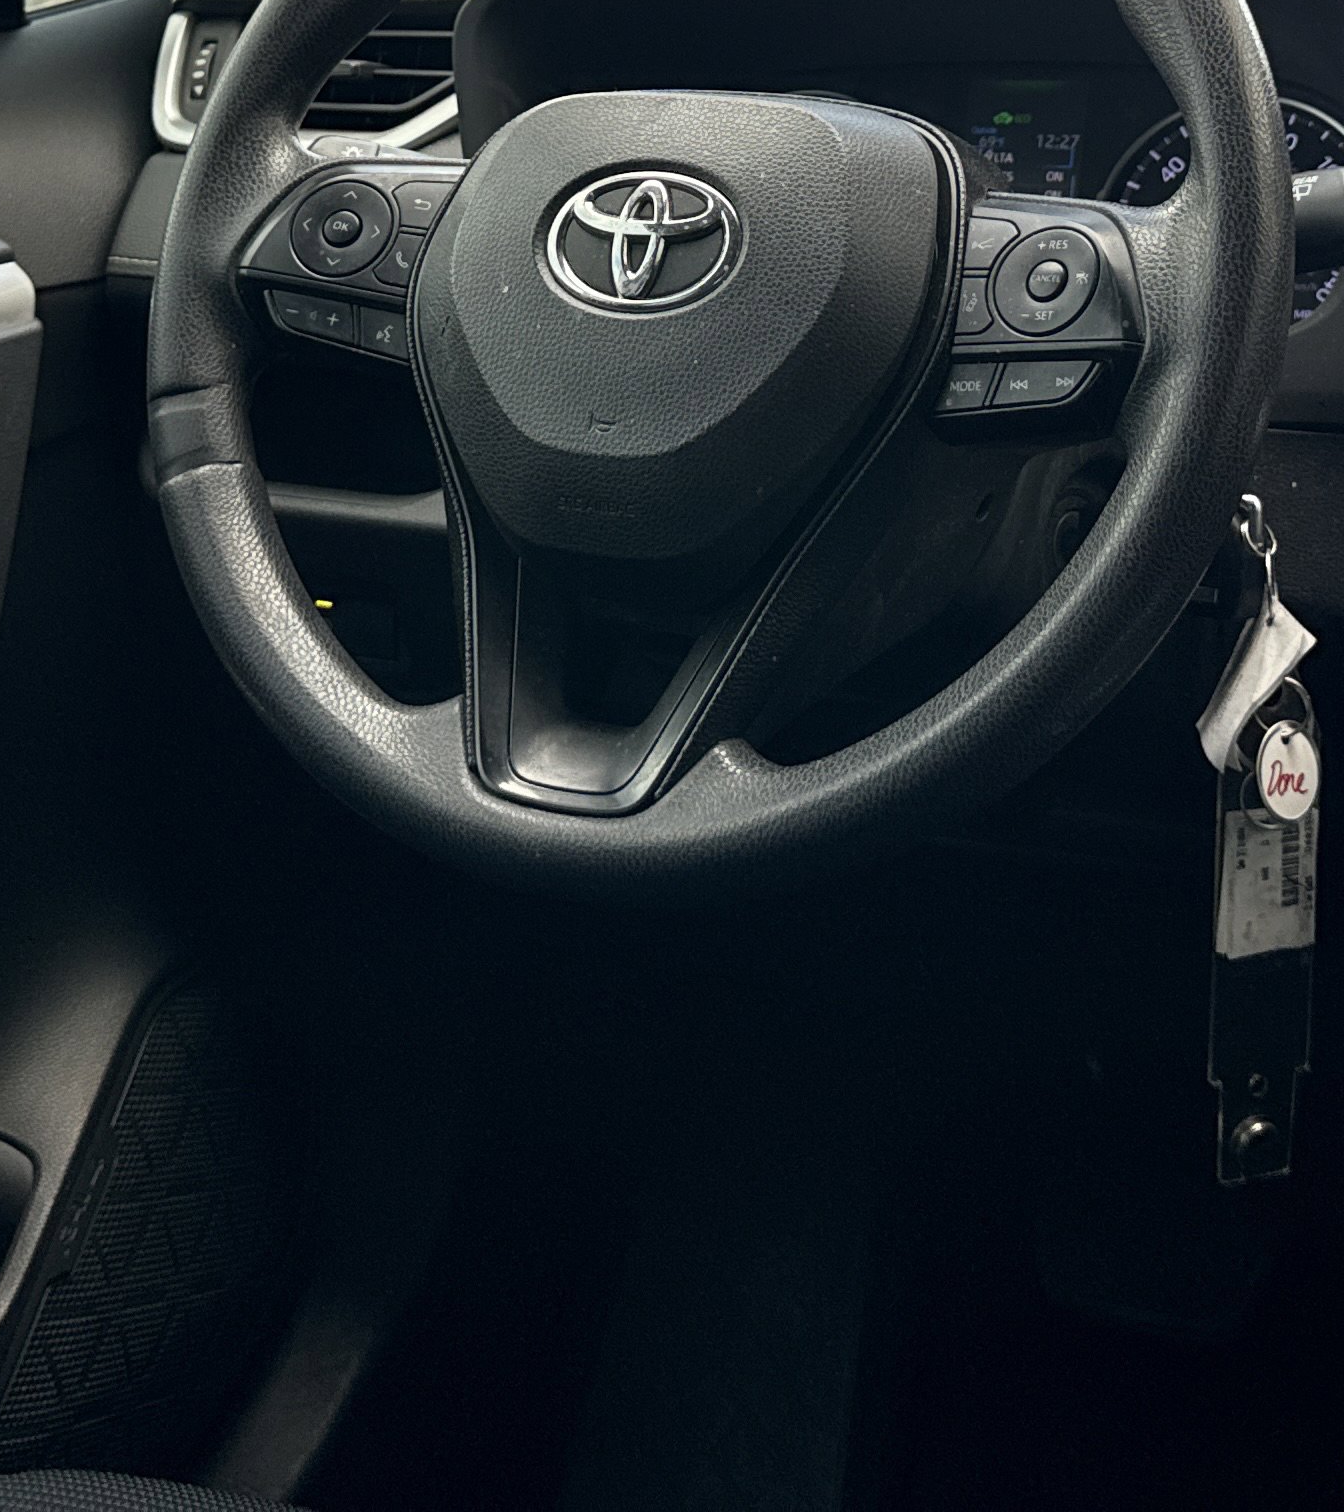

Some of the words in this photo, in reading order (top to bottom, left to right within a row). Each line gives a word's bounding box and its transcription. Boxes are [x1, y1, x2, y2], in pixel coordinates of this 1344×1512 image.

[1037, 134, 1081, 148] 12:27
[1161, 156, 1186, 183] 40
[1045, 171, 1065, 182] ON
[332, 221, 349, 232] OK
[1048, 239, 1069, 249] RES
[1034, 311, 1054, 320] SET
[949, 380, 981, 392] MODE
[1267, 759, 1308, 797] Done
